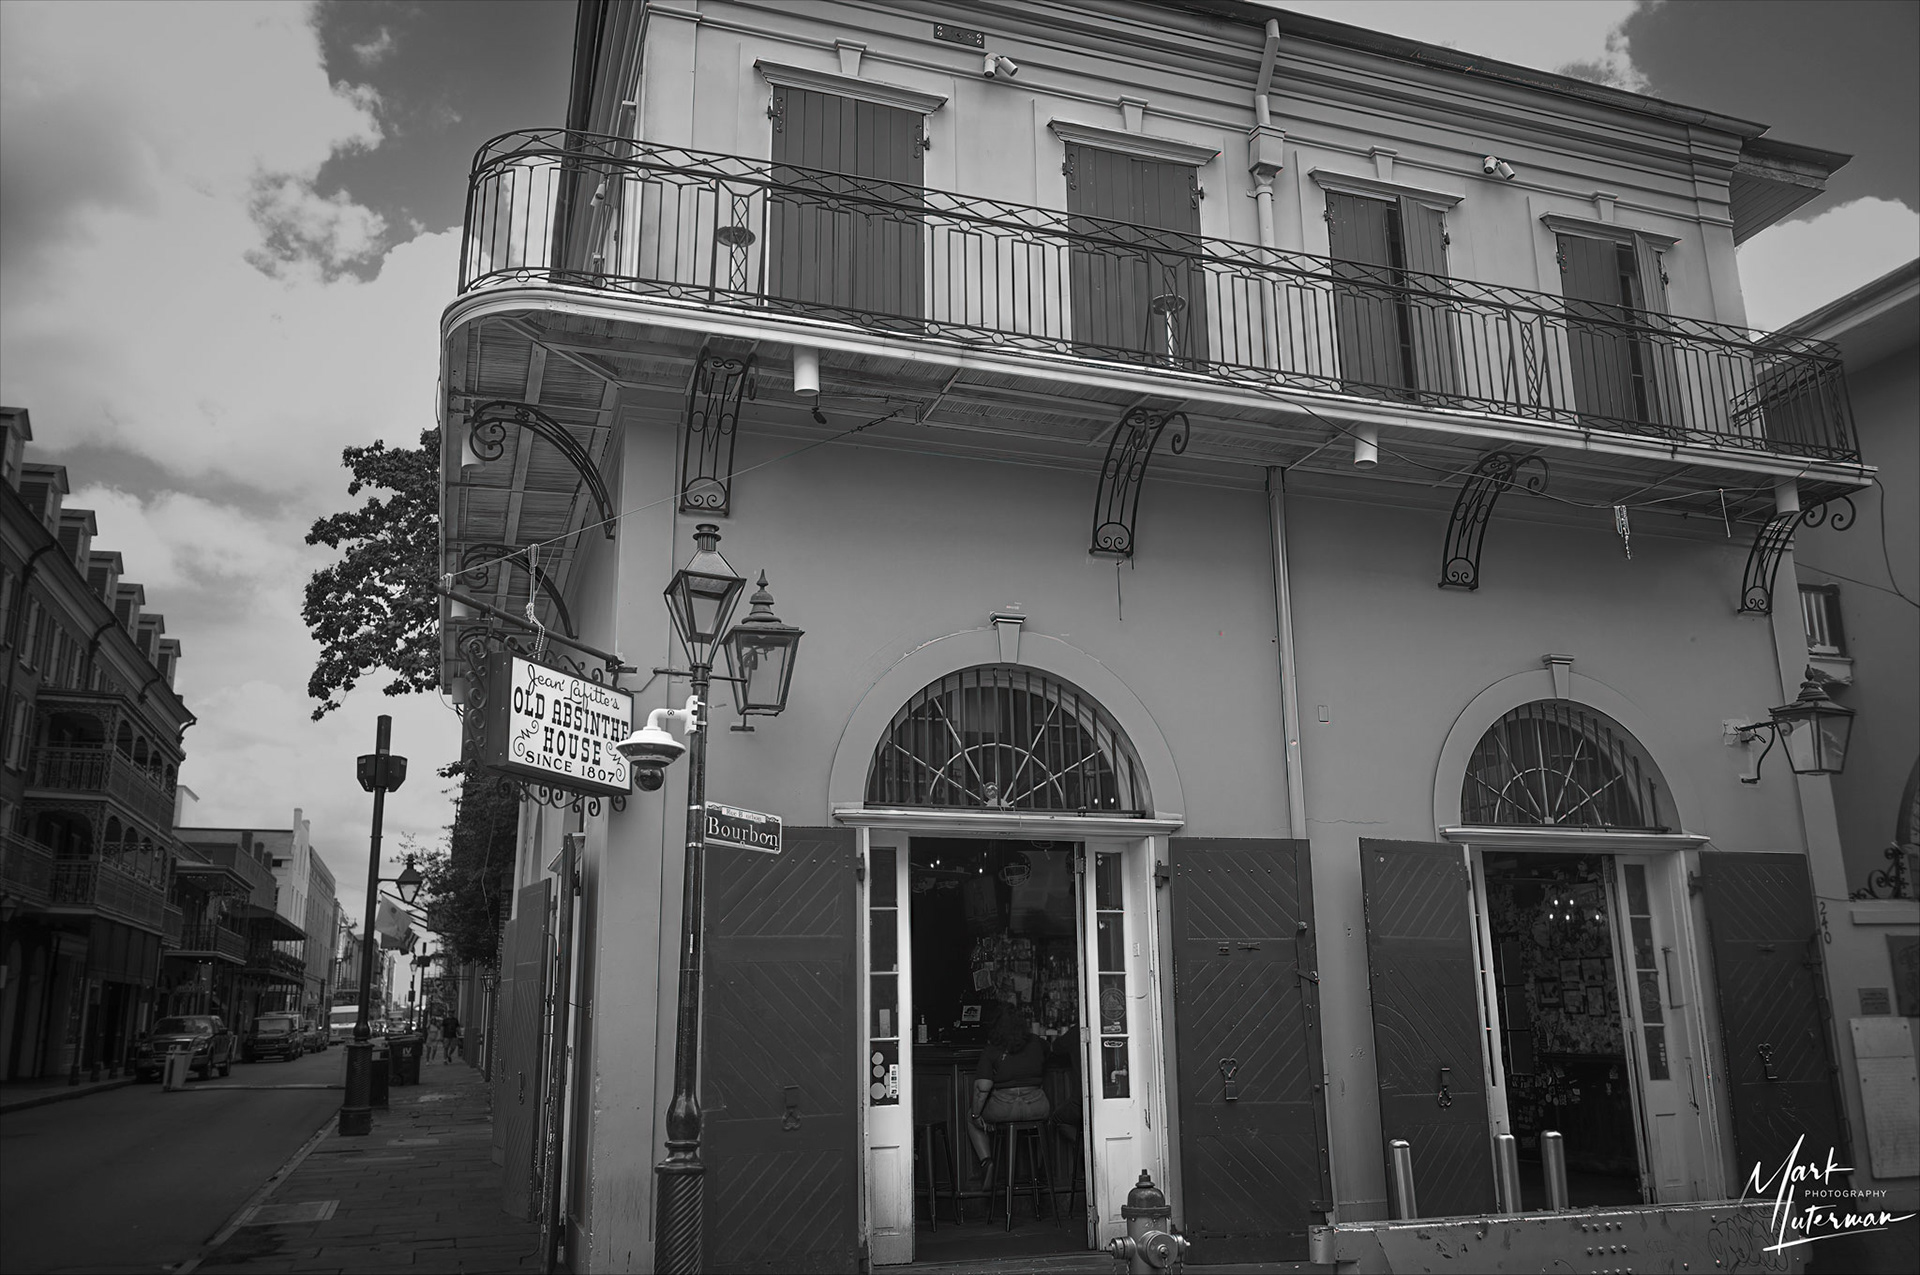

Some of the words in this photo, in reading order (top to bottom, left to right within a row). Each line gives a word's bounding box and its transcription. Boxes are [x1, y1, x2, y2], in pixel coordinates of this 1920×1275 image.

[514, 686, 545, 720] OLD
[551, 699, 629, 742] ABSINTHE
[543, 726, 601, 766] HOUSE
[525, 751, 573, 773] SINCE
[581, 765, 615, 783] 1807
[707, 816, 778, 846] Bourbon
